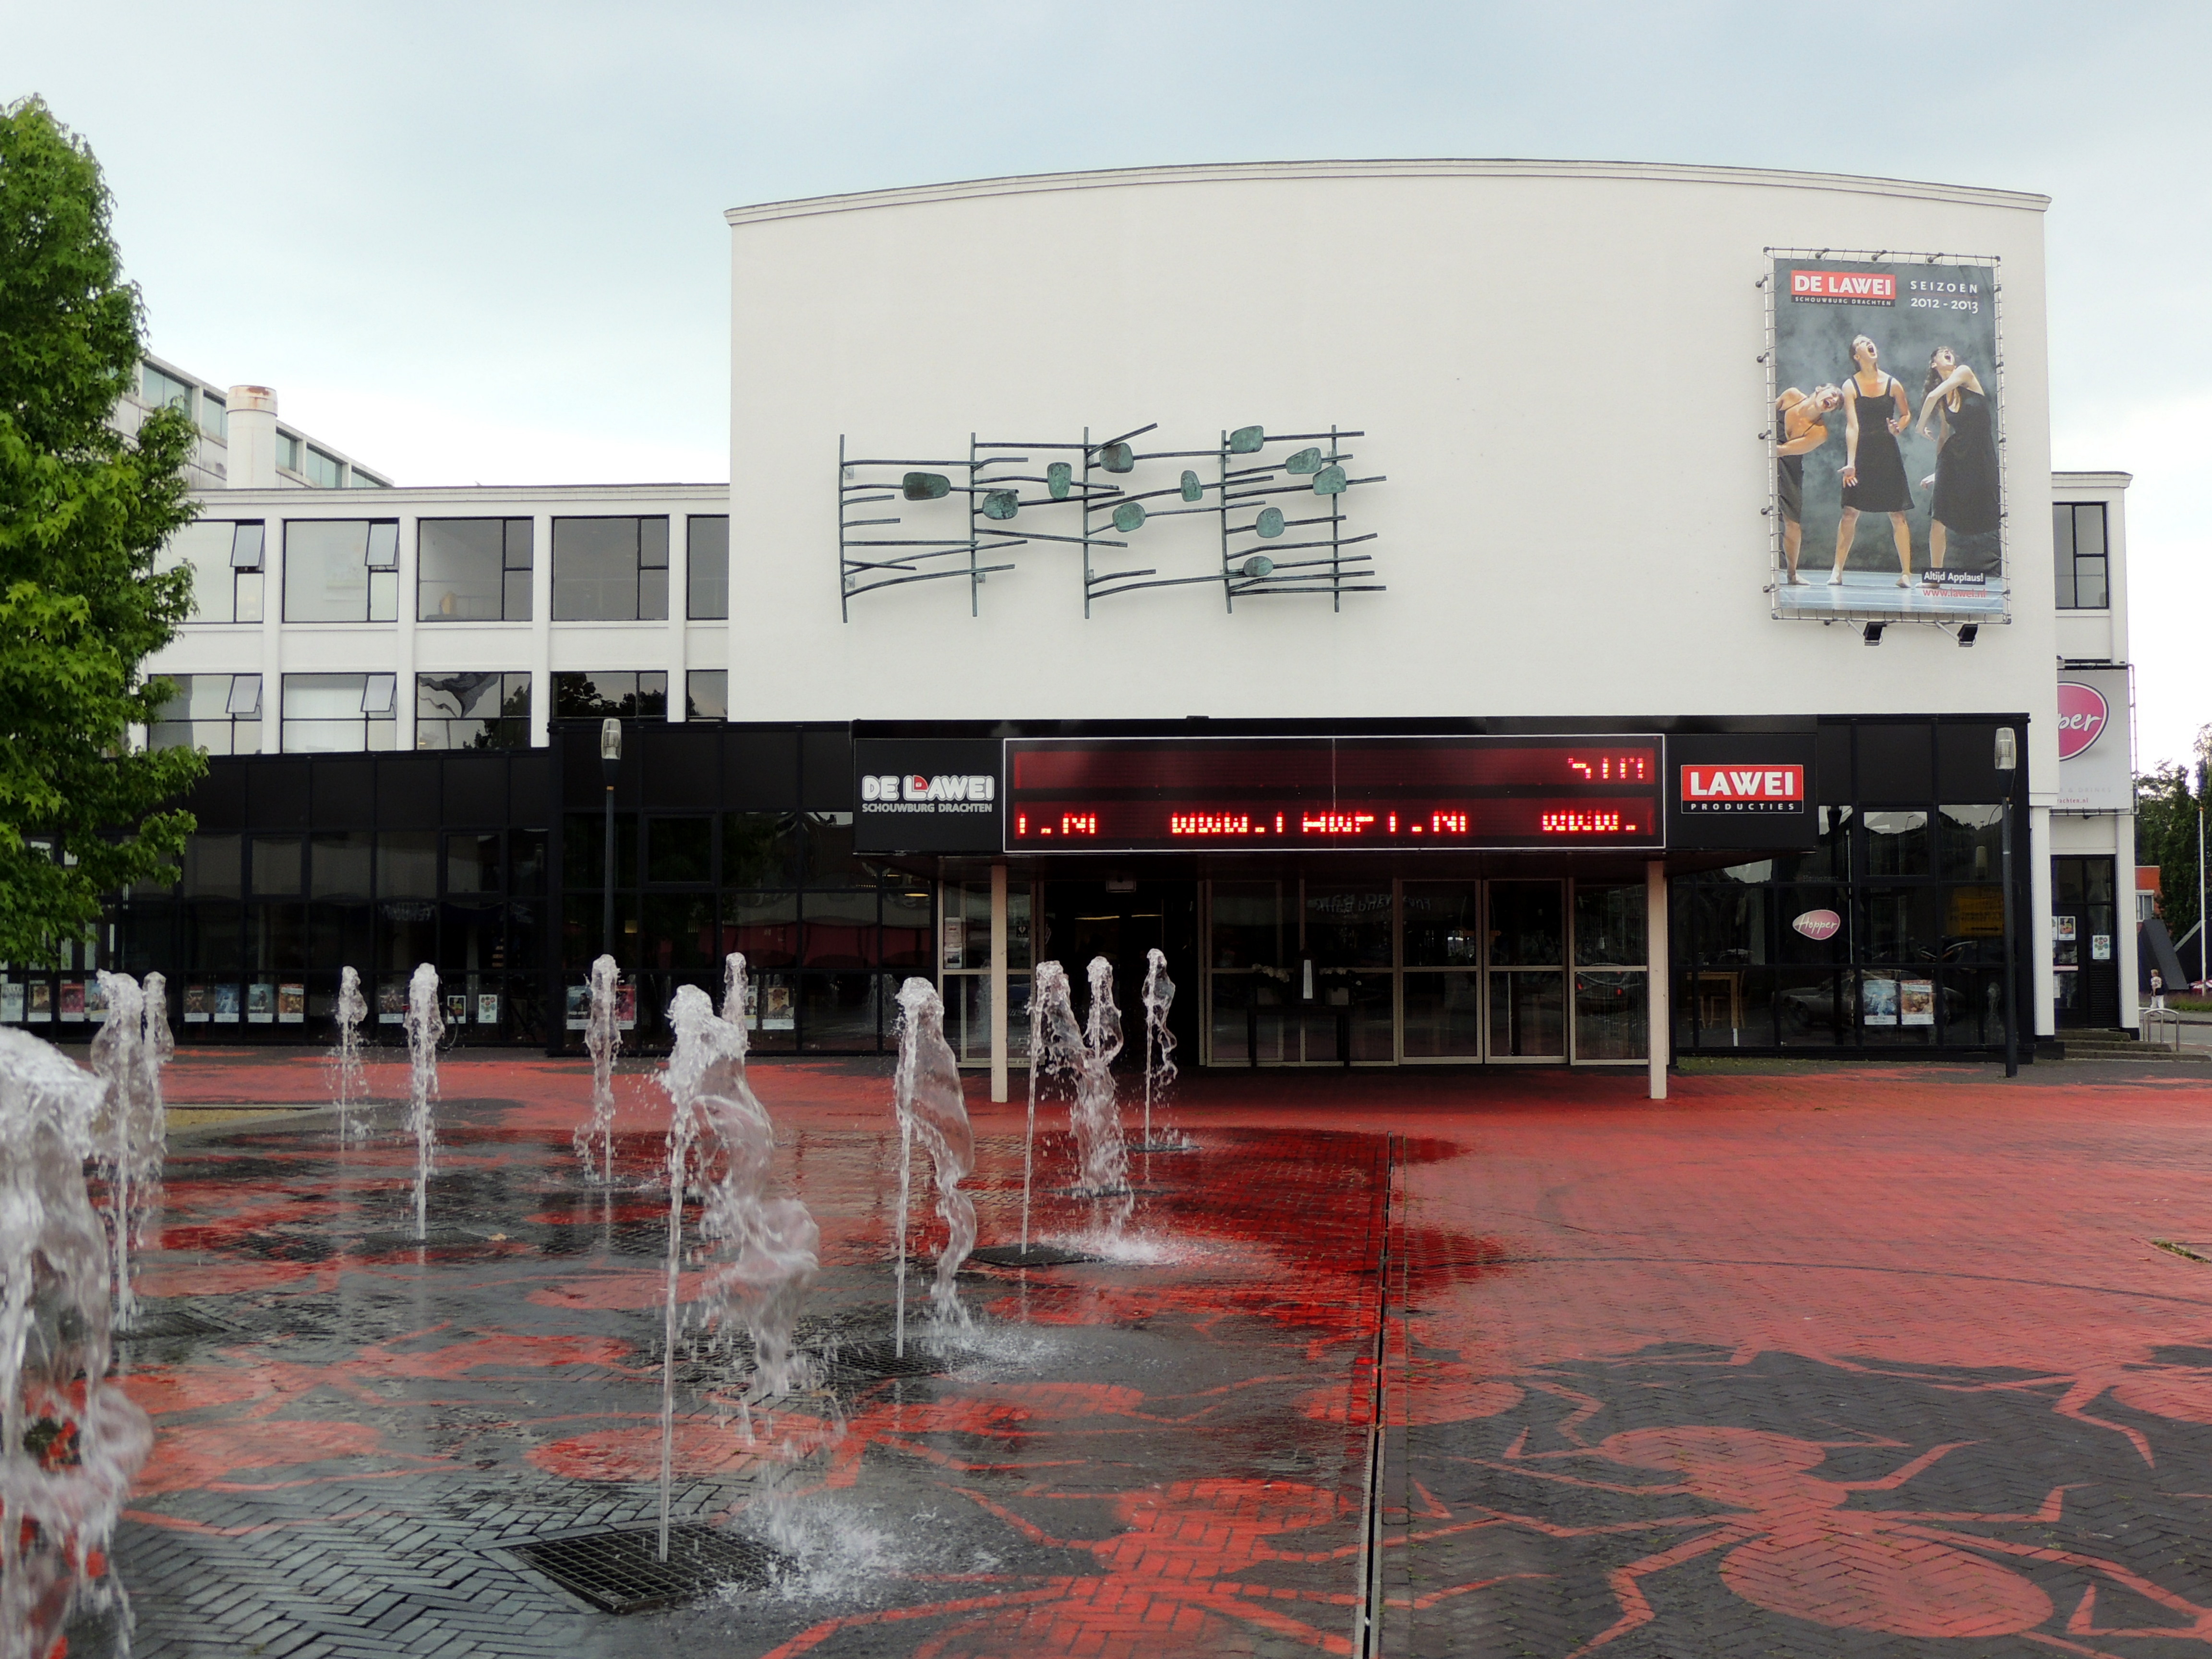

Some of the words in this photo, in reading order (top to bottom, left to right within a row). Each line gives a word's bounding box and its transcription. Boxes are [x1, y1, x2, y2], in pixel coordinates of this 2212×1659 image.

[1794, 275, 1822, 292] DE
[1828, 276, 1891, 295] LAWEI
[1910, 280, 1977, 294] SEIZOEN
[1911, 298, 1940, 308] 2012
[1950, 300, 1978, 314] 2013
[1923, 571, 1946, 583] Altijd
[1948, 572, 1984, 584] Applaus!
[1923, 587, 1986, 598] www.lawei.nl
[862, 775, 900, 801] DE
[903, 775, 994, 801] LAWEI
[1690, 772, 1794, 795] LAWEI
[862, 803, 935, 813] SCHOUWBURG
[938, 803, 993, 813] DRACHTEN
[1795, 914, 1838, 934] Hopper
